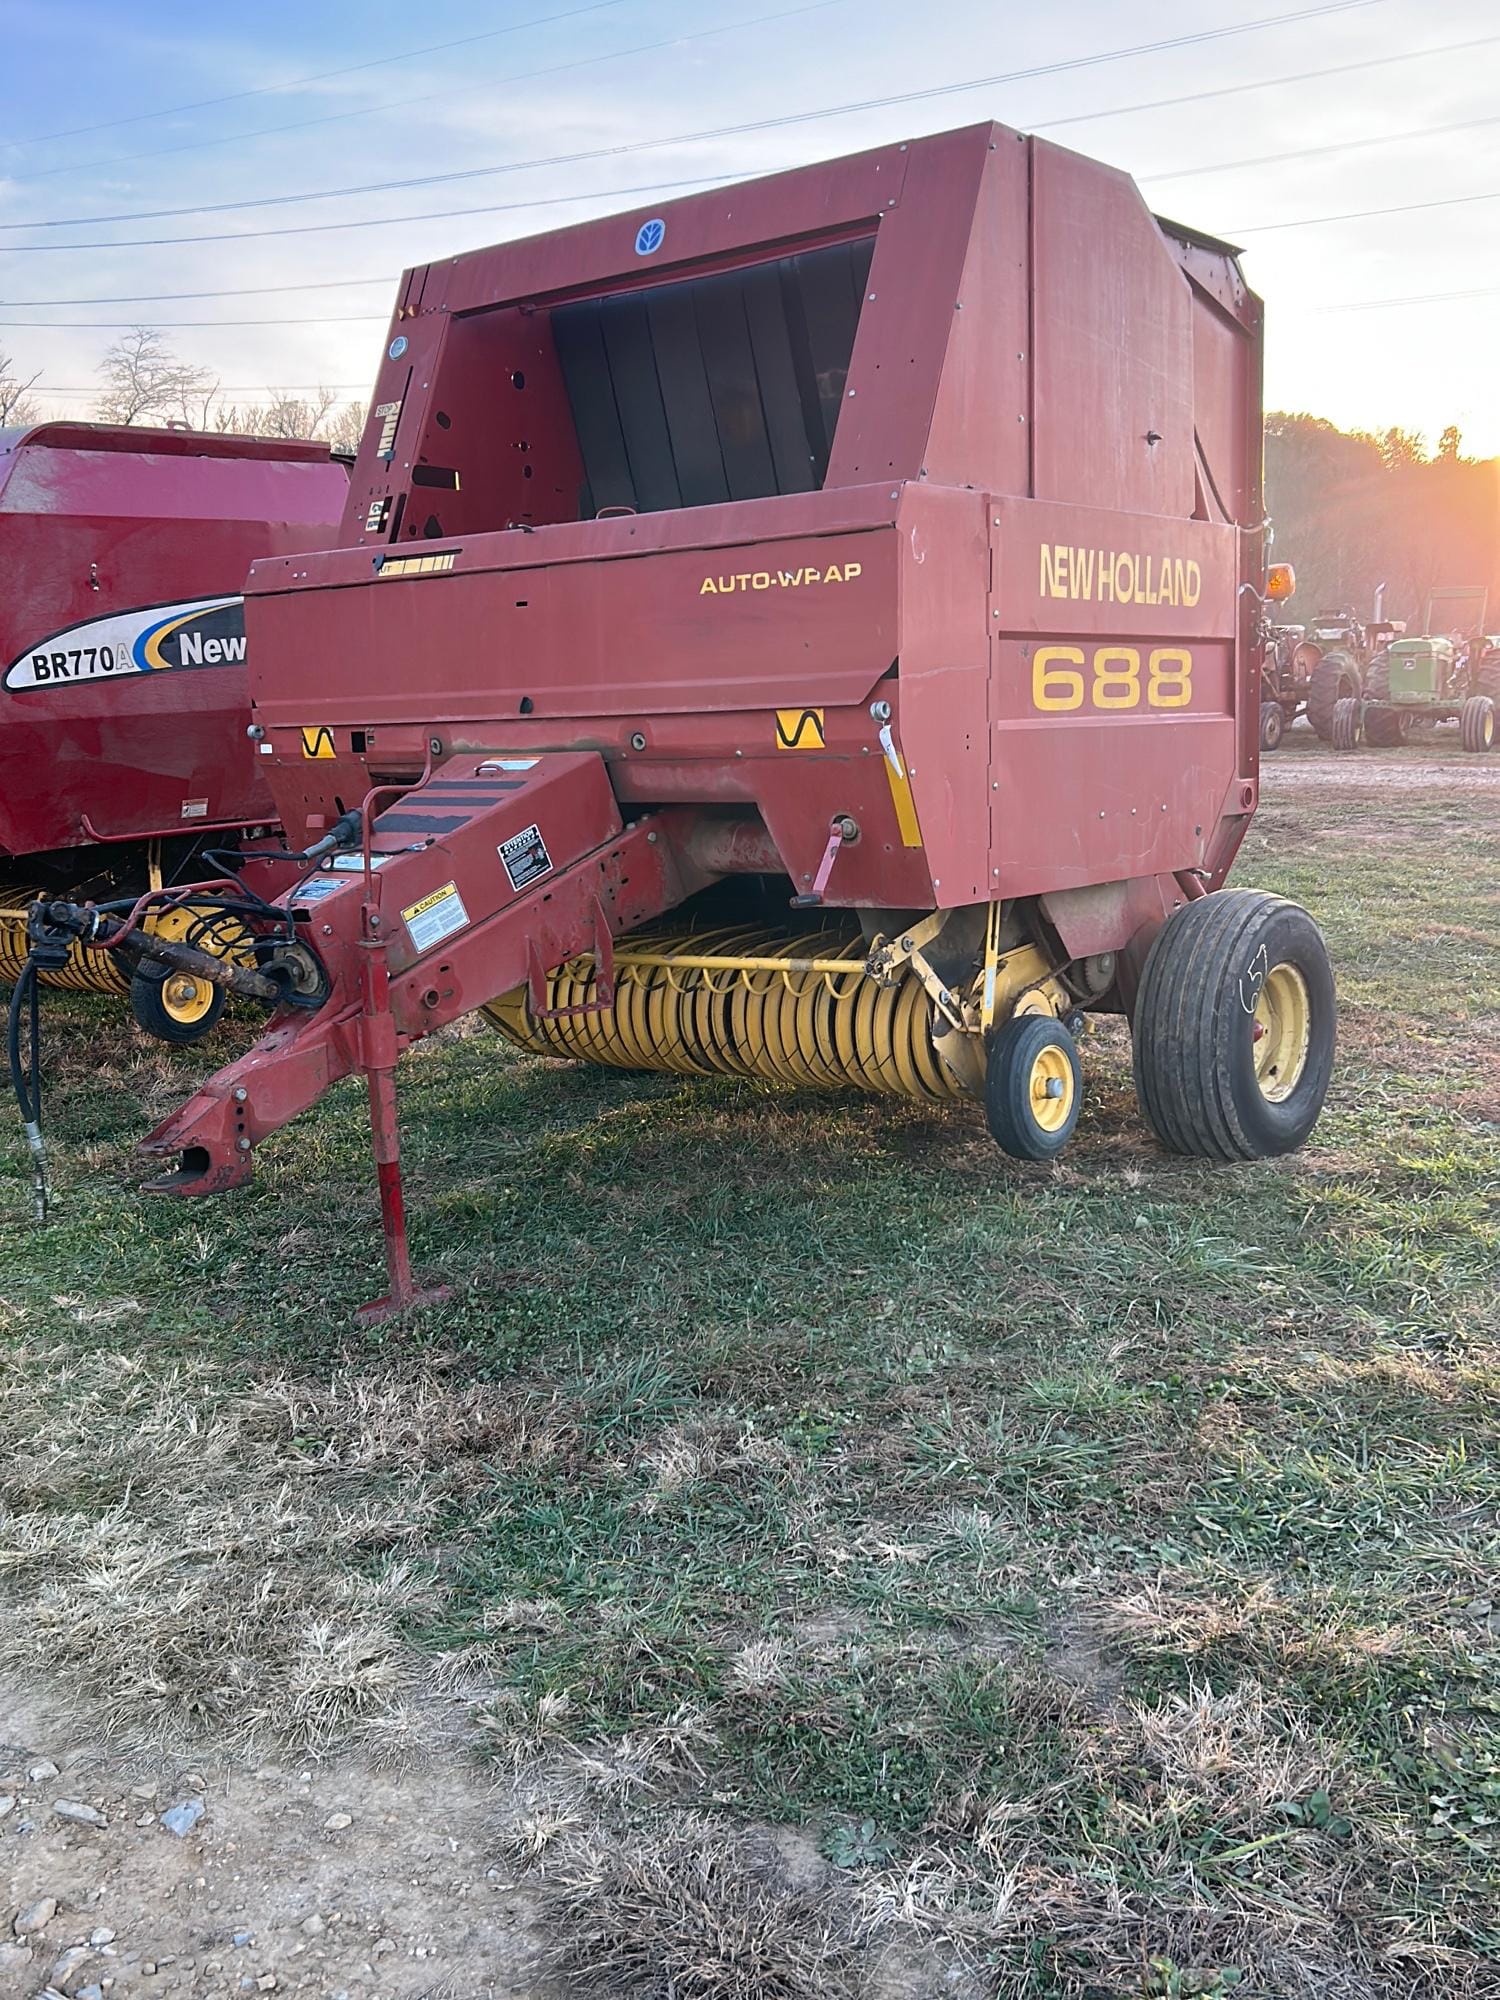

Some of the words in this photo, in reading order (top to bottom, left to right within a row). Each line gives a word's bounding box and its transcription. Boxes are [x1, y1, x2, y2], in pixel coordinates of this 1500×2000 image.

[700, 563, 862, 595] AUTO-WRAP
[1040, 544, 1095, 600] NEW
[1097, 550, 1201, 607] HOLLAND
[32, 643, 134, 681] BR770A
[179, 632, 247, 666] New
[1032, 646, 1193, 711] 688
[503, 829, 535, 851] ATTENTION
[419, 889, 447, 910] CAUTION
